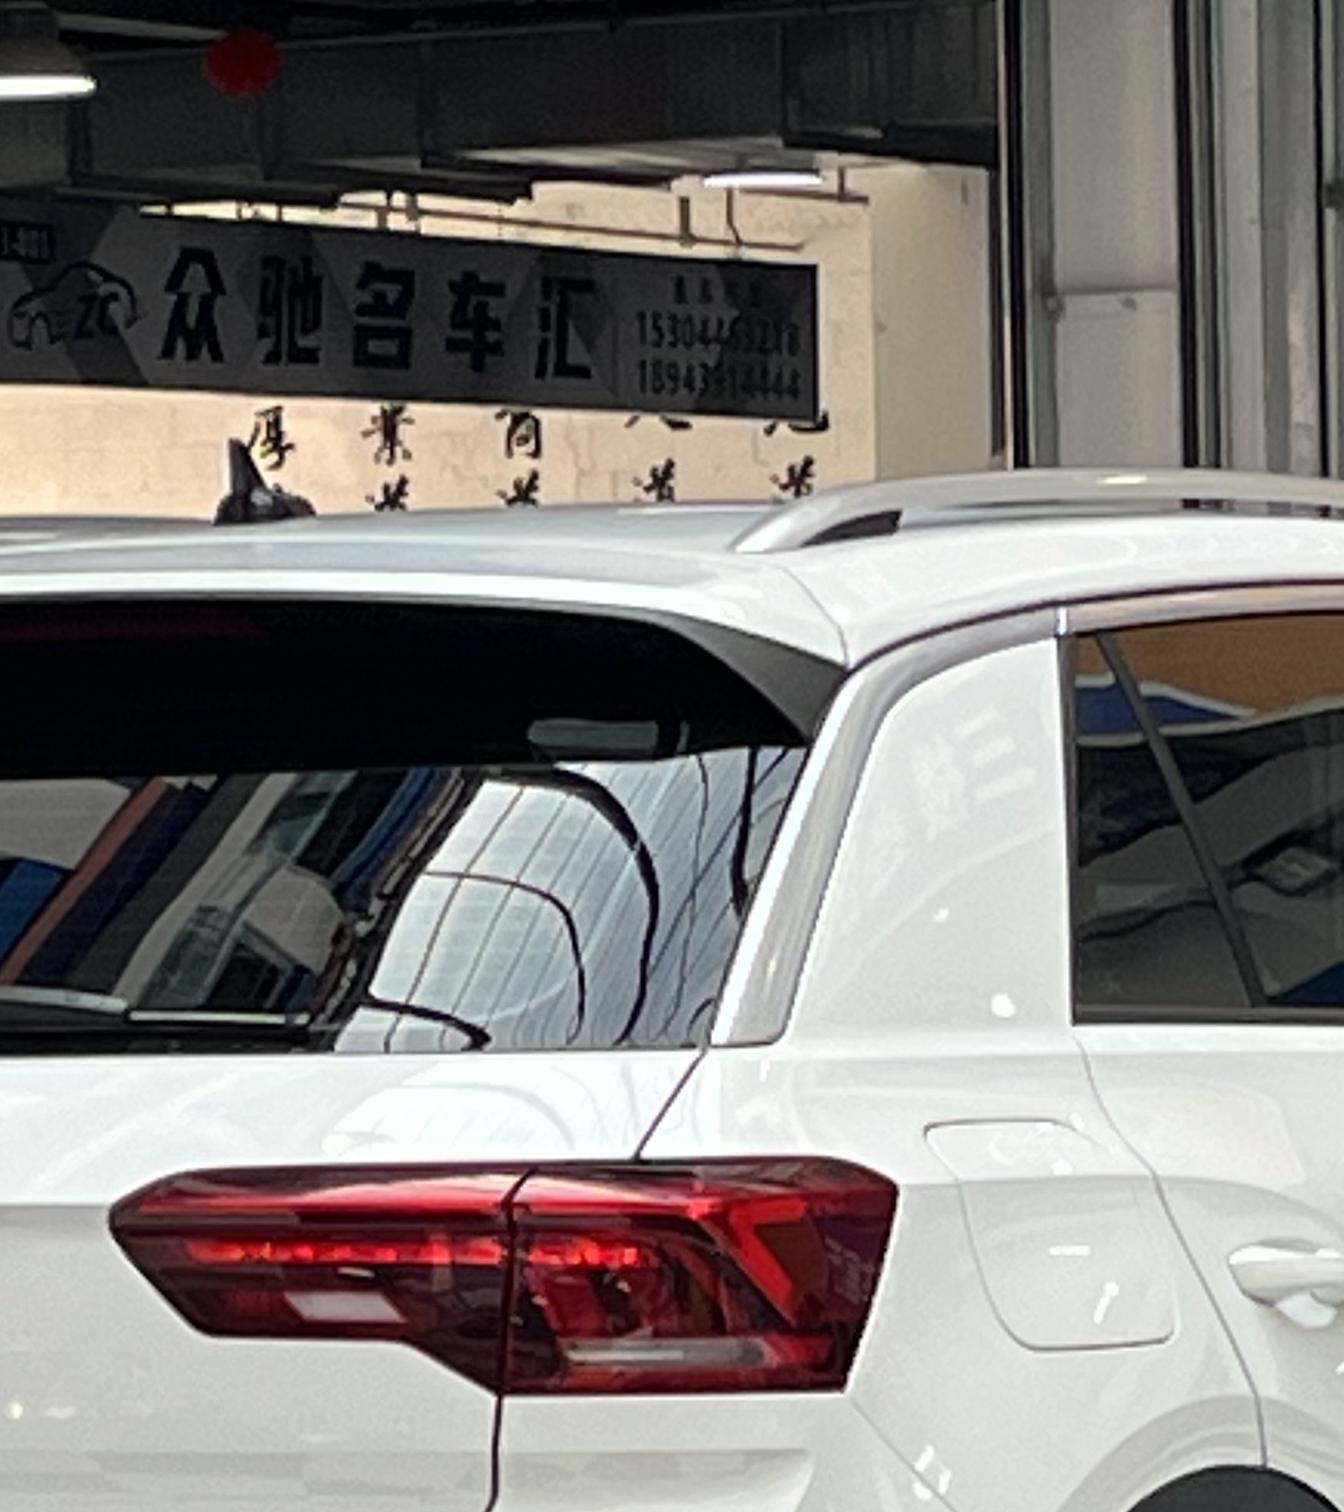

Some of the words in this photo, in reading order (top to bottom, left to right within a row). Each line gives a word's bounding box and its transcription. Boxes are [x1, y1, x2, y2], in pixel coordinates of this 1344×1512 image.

[158, 245, 595, 380] 众驰名车汇
